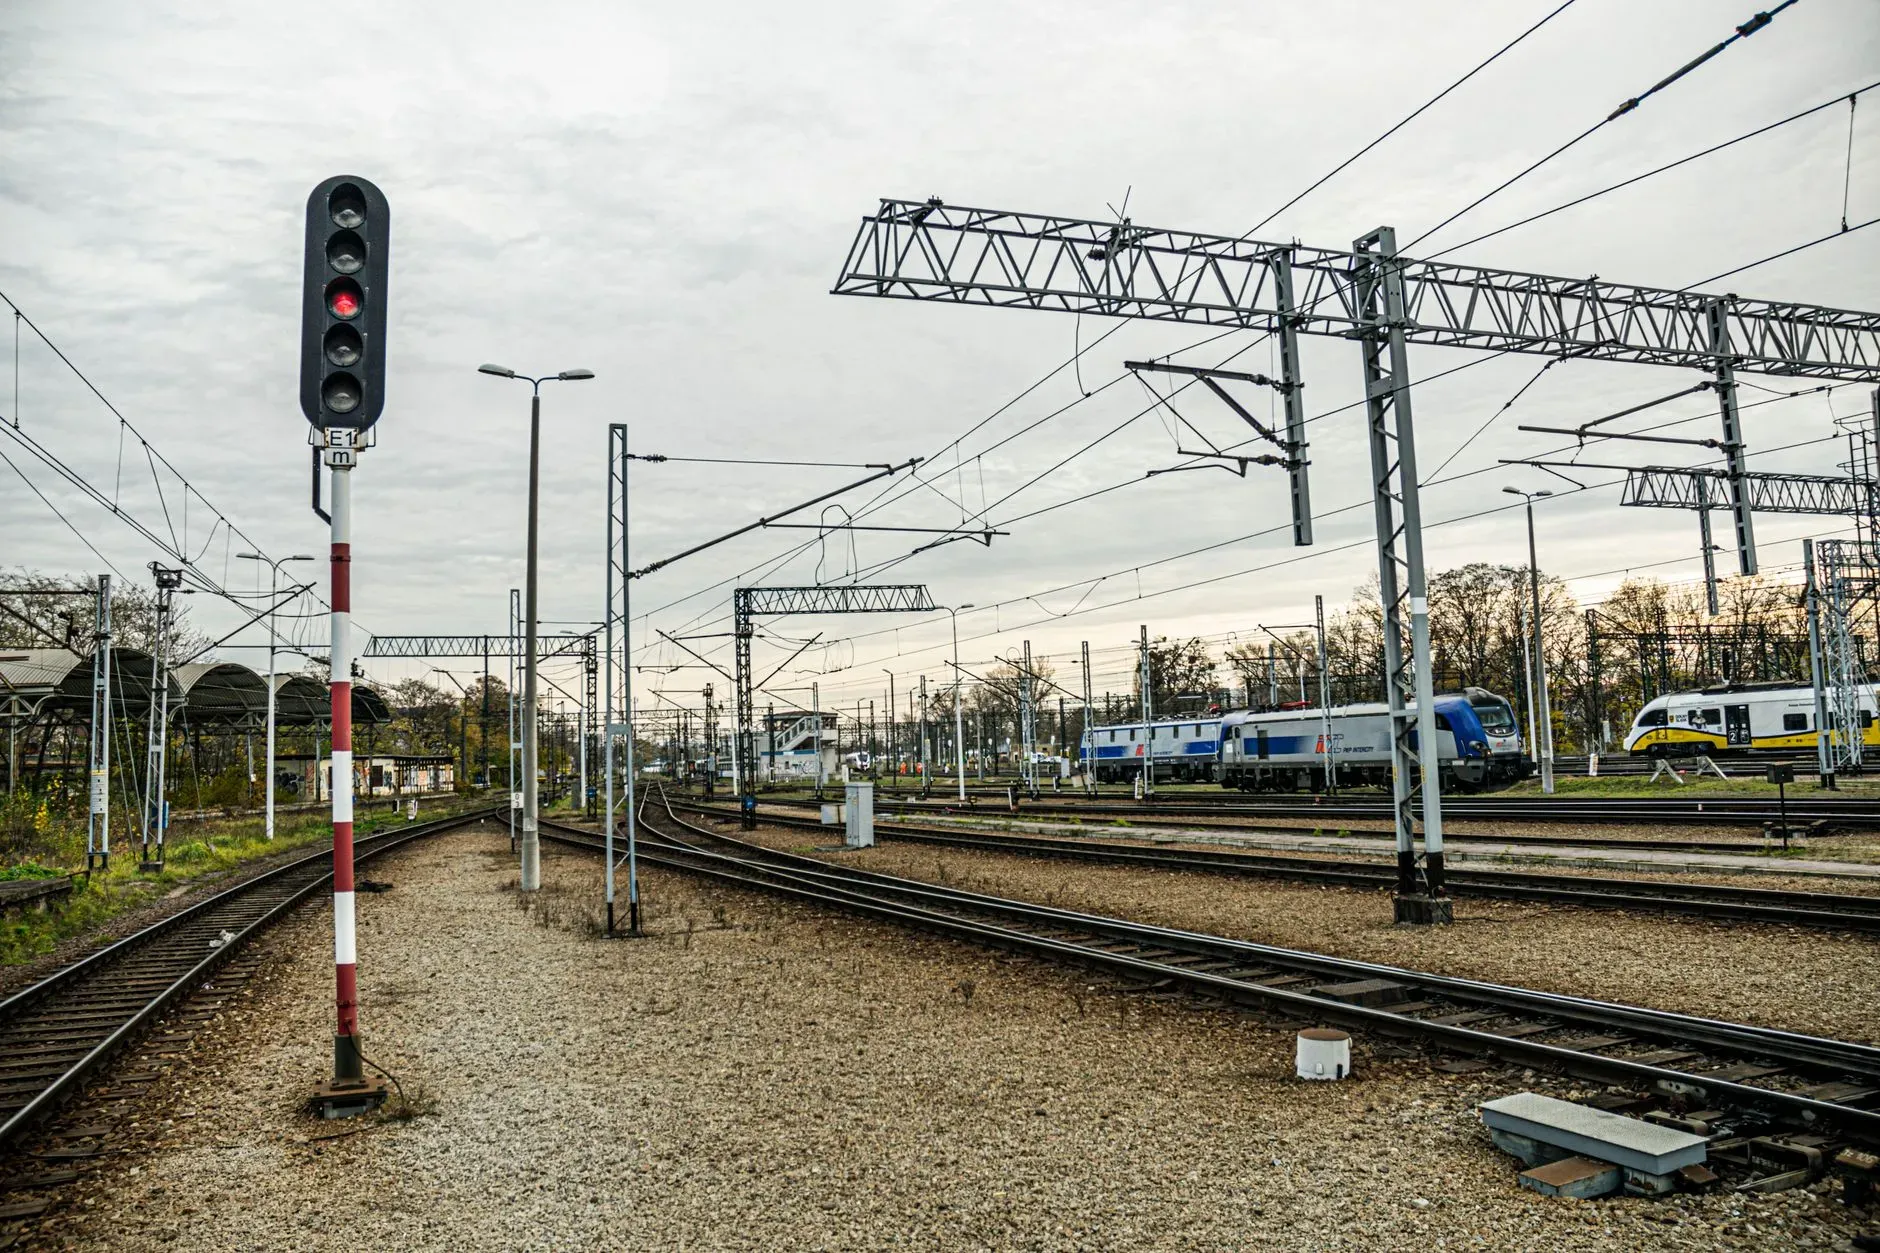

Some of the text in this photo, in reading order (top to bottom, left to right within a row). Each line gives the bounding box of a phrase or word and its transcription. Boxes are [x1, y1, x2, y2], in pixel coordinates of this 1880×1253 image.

[330, 430, 352, 446] E1
[332, 451, 350, 463] m
[1730, 732, 1736, 742] 2
